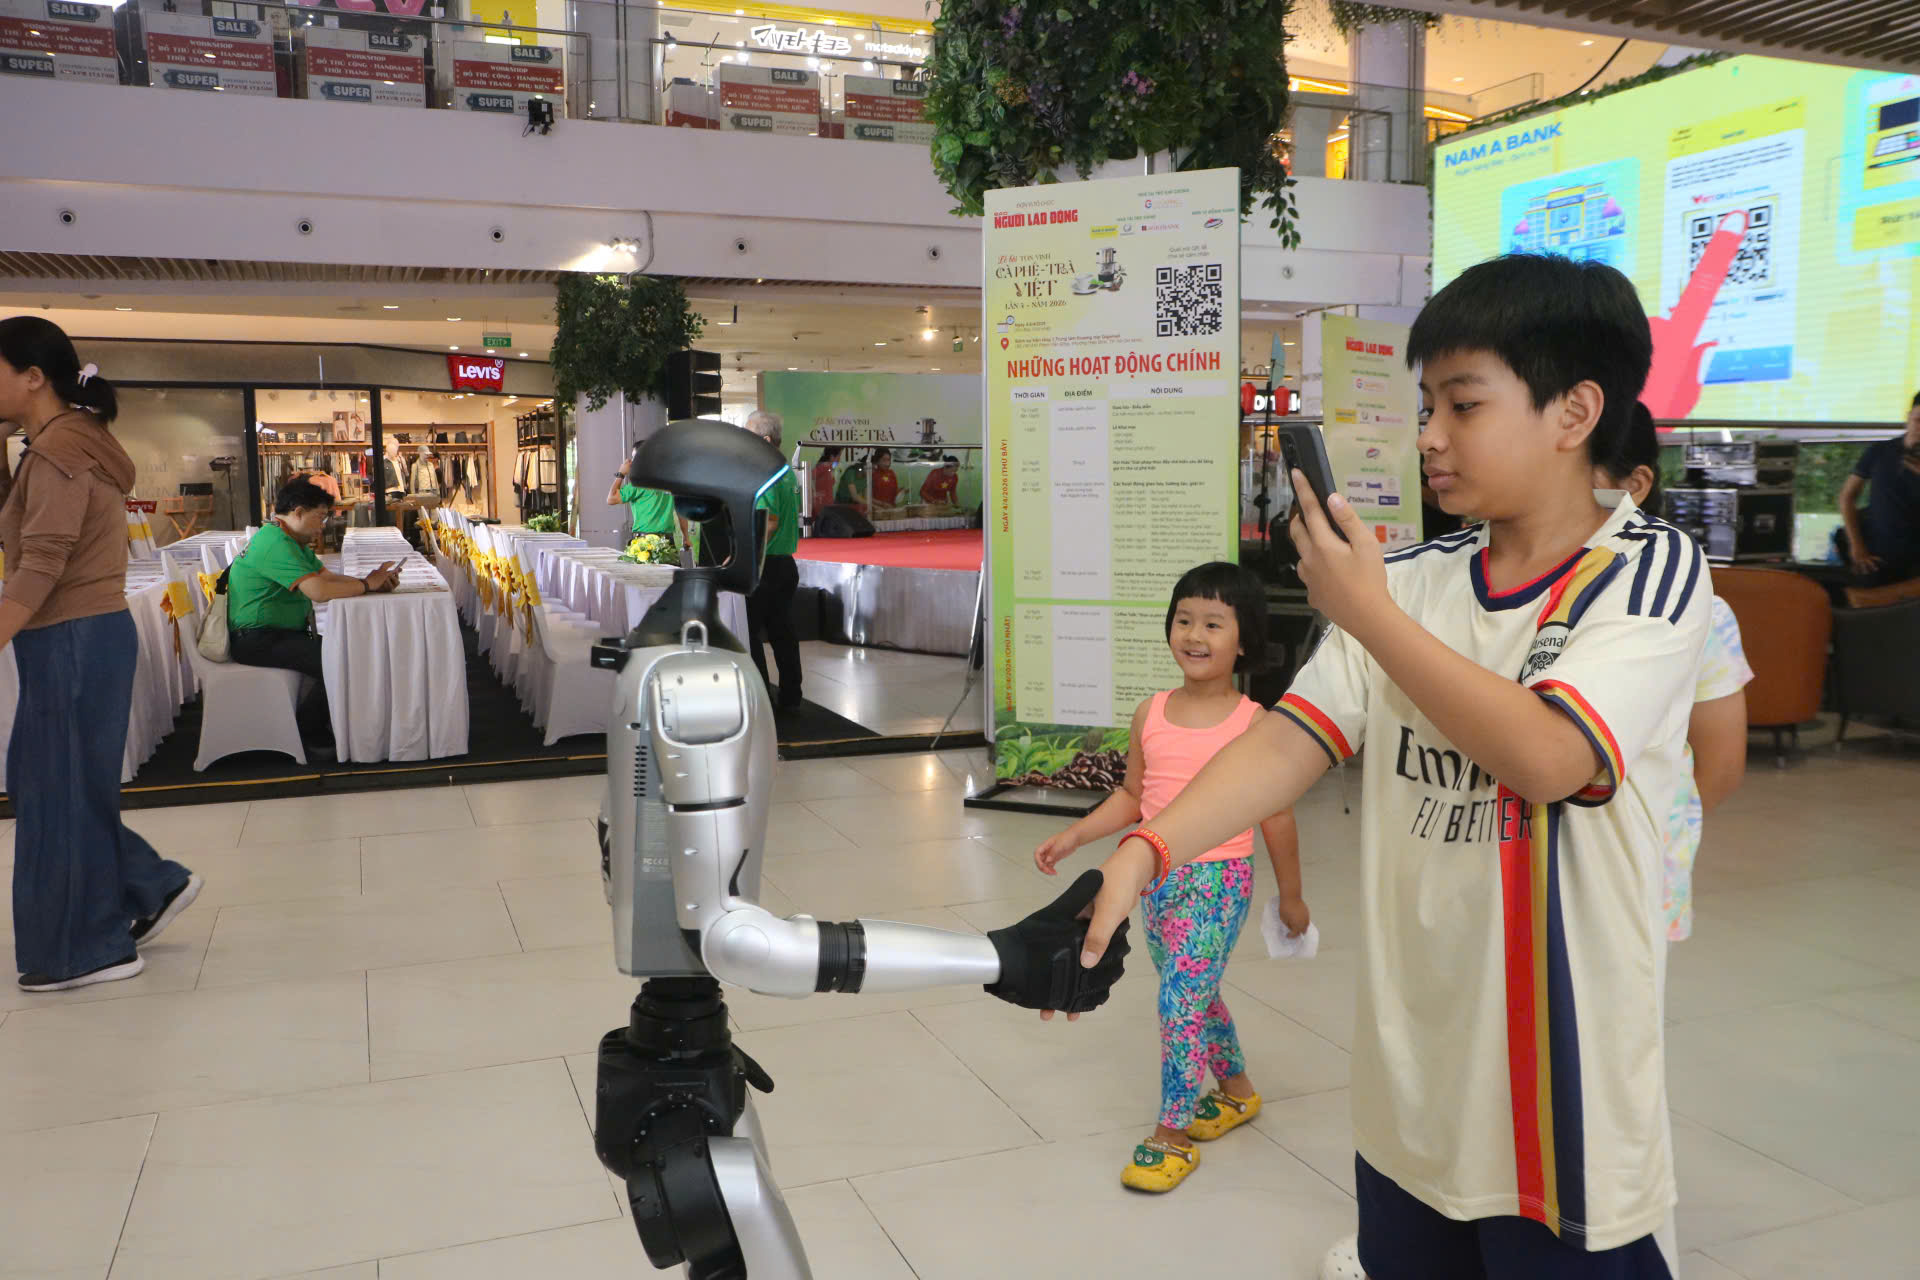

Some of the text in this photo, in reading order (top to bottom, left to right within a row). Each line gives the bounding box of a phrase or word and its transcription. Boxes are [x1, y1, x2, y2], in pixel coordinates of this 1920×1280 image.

[52, 3, 85, 16] SALE
[217, 21, 247, 32] SALE
[190, 40, 233, 49] WORKSHOP
[371, 35, 399, 46] SALE
[346, 53, 386, 62] WORKSHOP
[514, 48, 541, 58] SALE
[9, 58, 53, 72] SUPER
[374, 64, 415, 72] HANDMADE
[490, 65, 529, 73] WORKSHOP
[177, 74, 217, 86] SUPER
[517, 75, 554, 83] HANDMADE
[774, 71, 798, 81] SALE
[333, 86, 370, 97] SUPER
[895, 82, 918, 92] SALE
[478, 97, 513, 108] SUPER
[741, 117, 772, 128] SUPER
[864, 127, 893, 137] SUPER
[1445, 143, 1487, 169] NAM
[1490, 140, 1503, 156] A
[1506, 121, 1562, 151] BANK
[1028, 212, 1047, 226] LAO
[487, 338, 503, 346] EXIT
[1007, 348, 1221, 380] NHỮNG HOẠT ĐỘNG CHÍNH
[1030, 391, 1045, 399] GIAN
[1163, 386, 1183, 394] DUNG
[1444, 797, 1534, 843] BETTER
